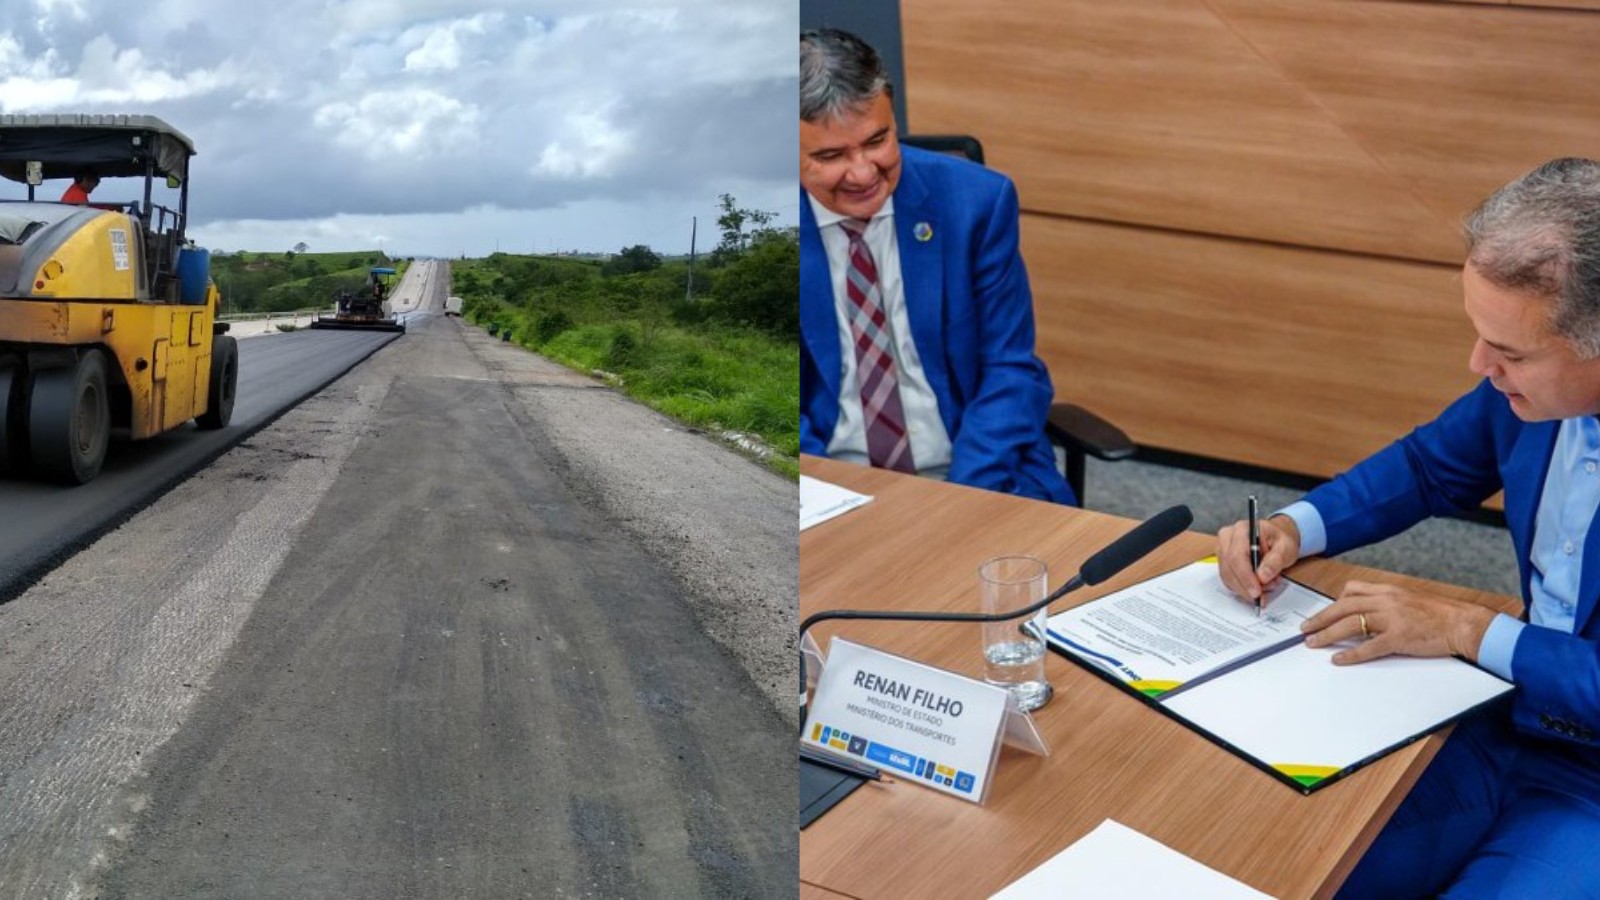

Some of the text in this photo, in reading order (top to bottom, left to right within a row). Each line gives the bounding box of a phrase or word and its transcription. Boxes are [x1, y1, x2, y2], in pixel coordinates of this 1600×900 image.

[854, 670, 963, 718] RENAN FILHO
[866, 696, 943, 727] MINISTRO DE ESTADO
[846, 703, 957, 746] MINISTÉRIO DOS TRANSPORTES
